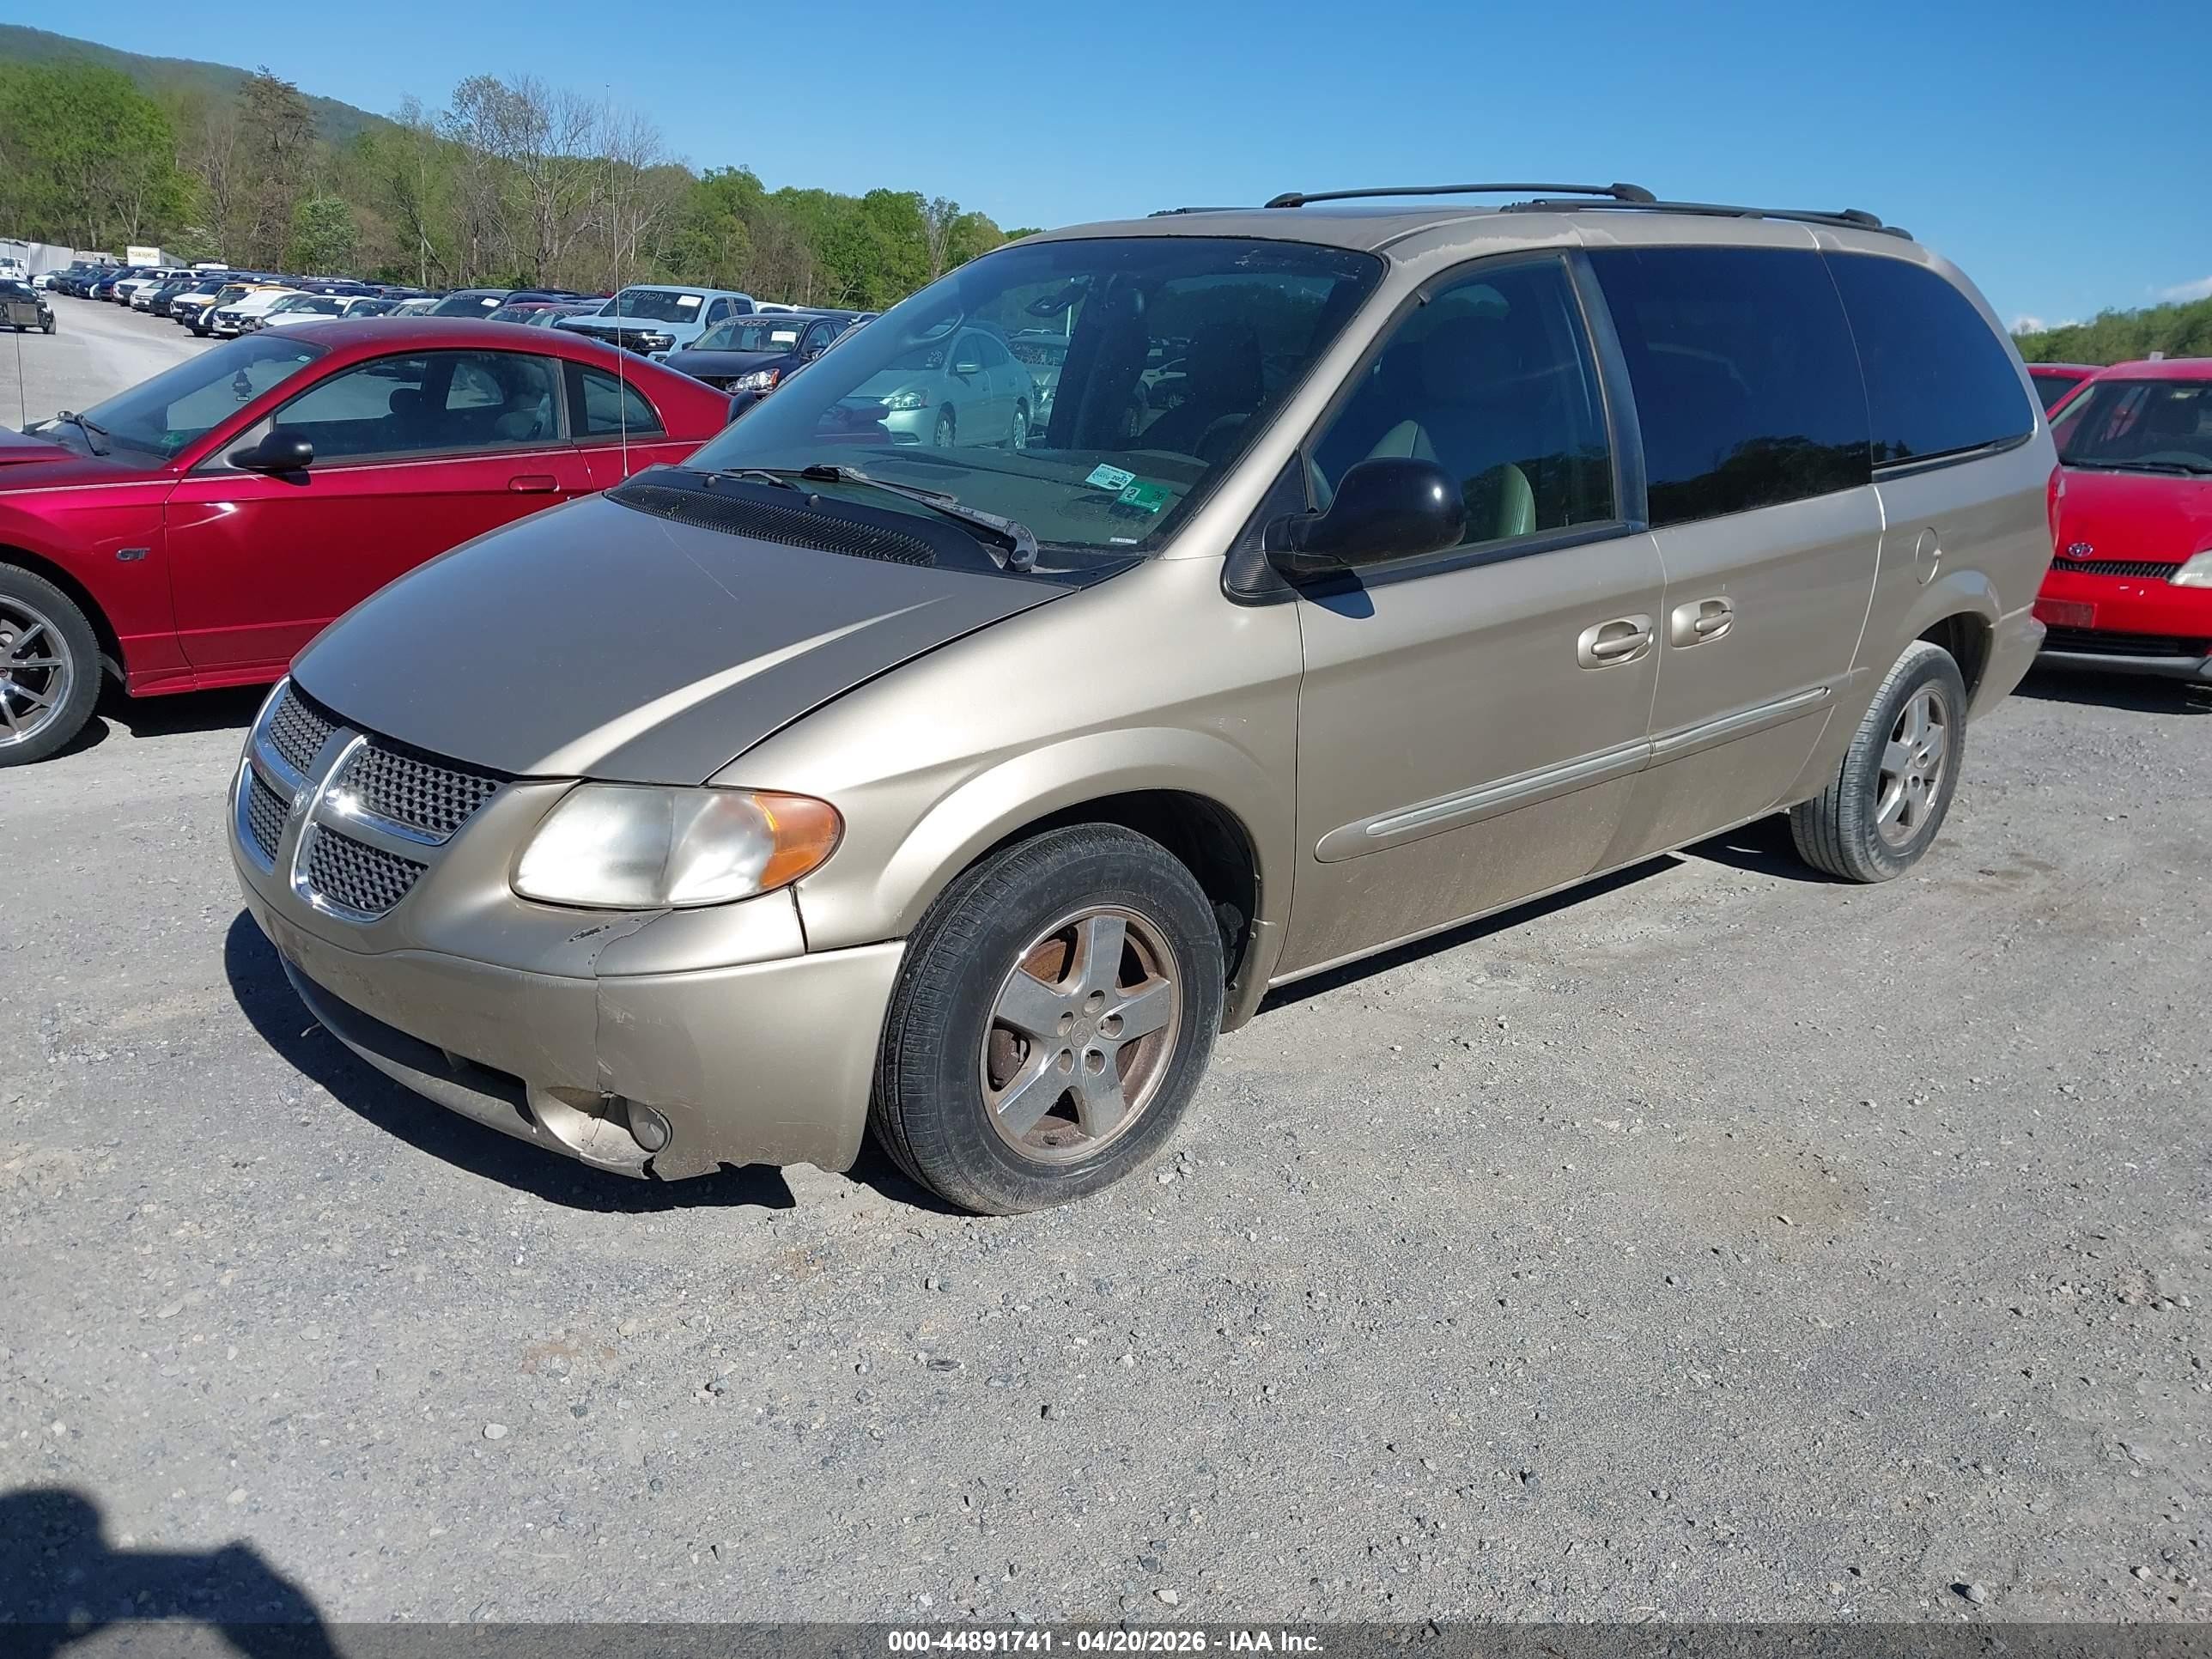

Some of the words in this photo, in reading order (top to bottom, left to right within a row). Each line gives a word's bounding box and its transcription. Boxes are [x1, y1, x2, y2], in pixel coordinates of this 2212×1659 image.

[1111, 475, 1128, 484] 2025
[1127, 489, 1137, 498] 2
[116, 547, 151, 561] GT
